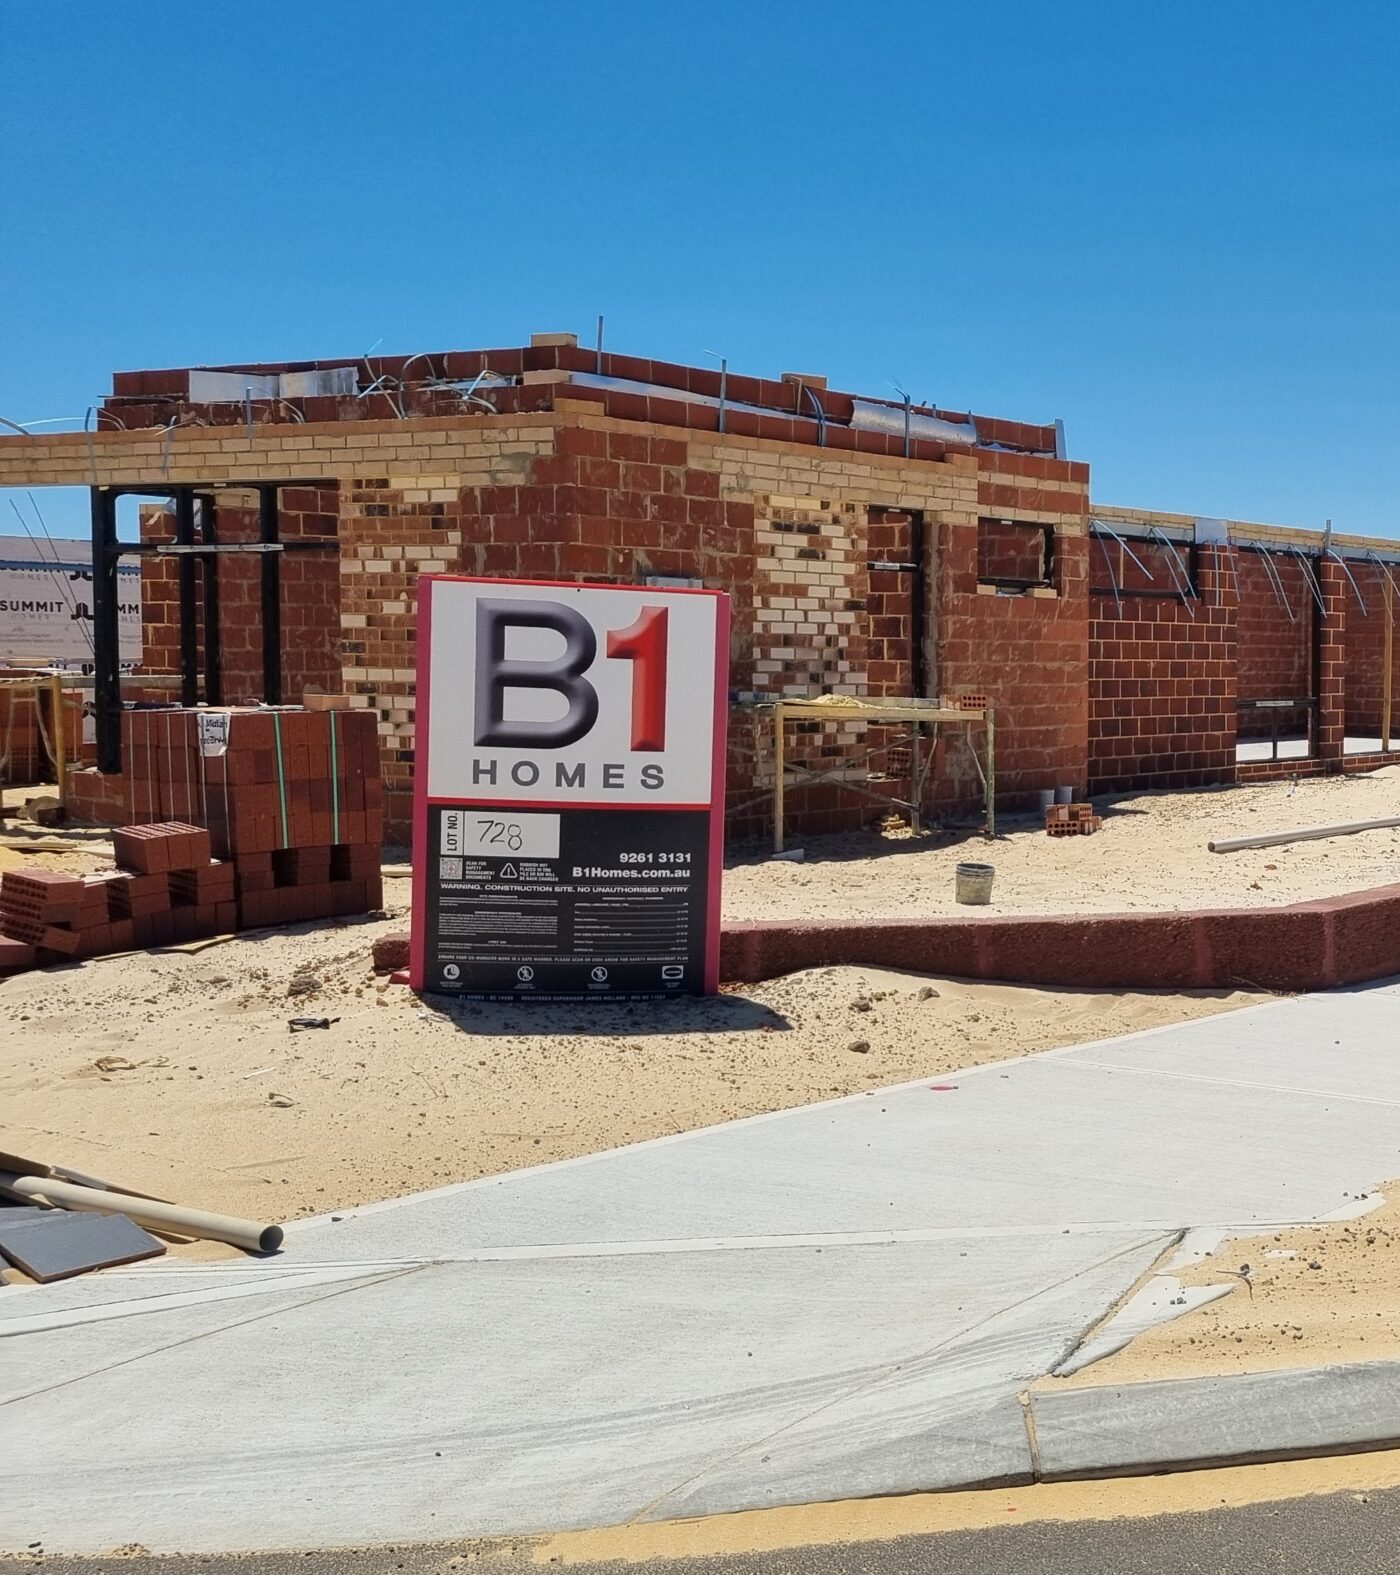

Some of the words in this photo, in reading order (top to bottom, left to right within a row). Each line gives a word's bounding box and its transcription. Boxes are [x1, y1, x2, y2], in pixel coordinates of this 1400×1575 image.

[0, 600, 64, 613] SUMMIT
[474, 597, 668, 752] B1
[472, 759, 664, 789] HOMES
[447, 812, 458, 830] NO.
[447, 832, 458, 851] LOT
[477, 820, 522, 851] 728
[619, 852, 654, 863] 9261
[658, 852, 691, 863] 3131
[572, 866, 690, 878] B1Homes.com.au
[485, 884, 552, 892] CONSTRUCTION
